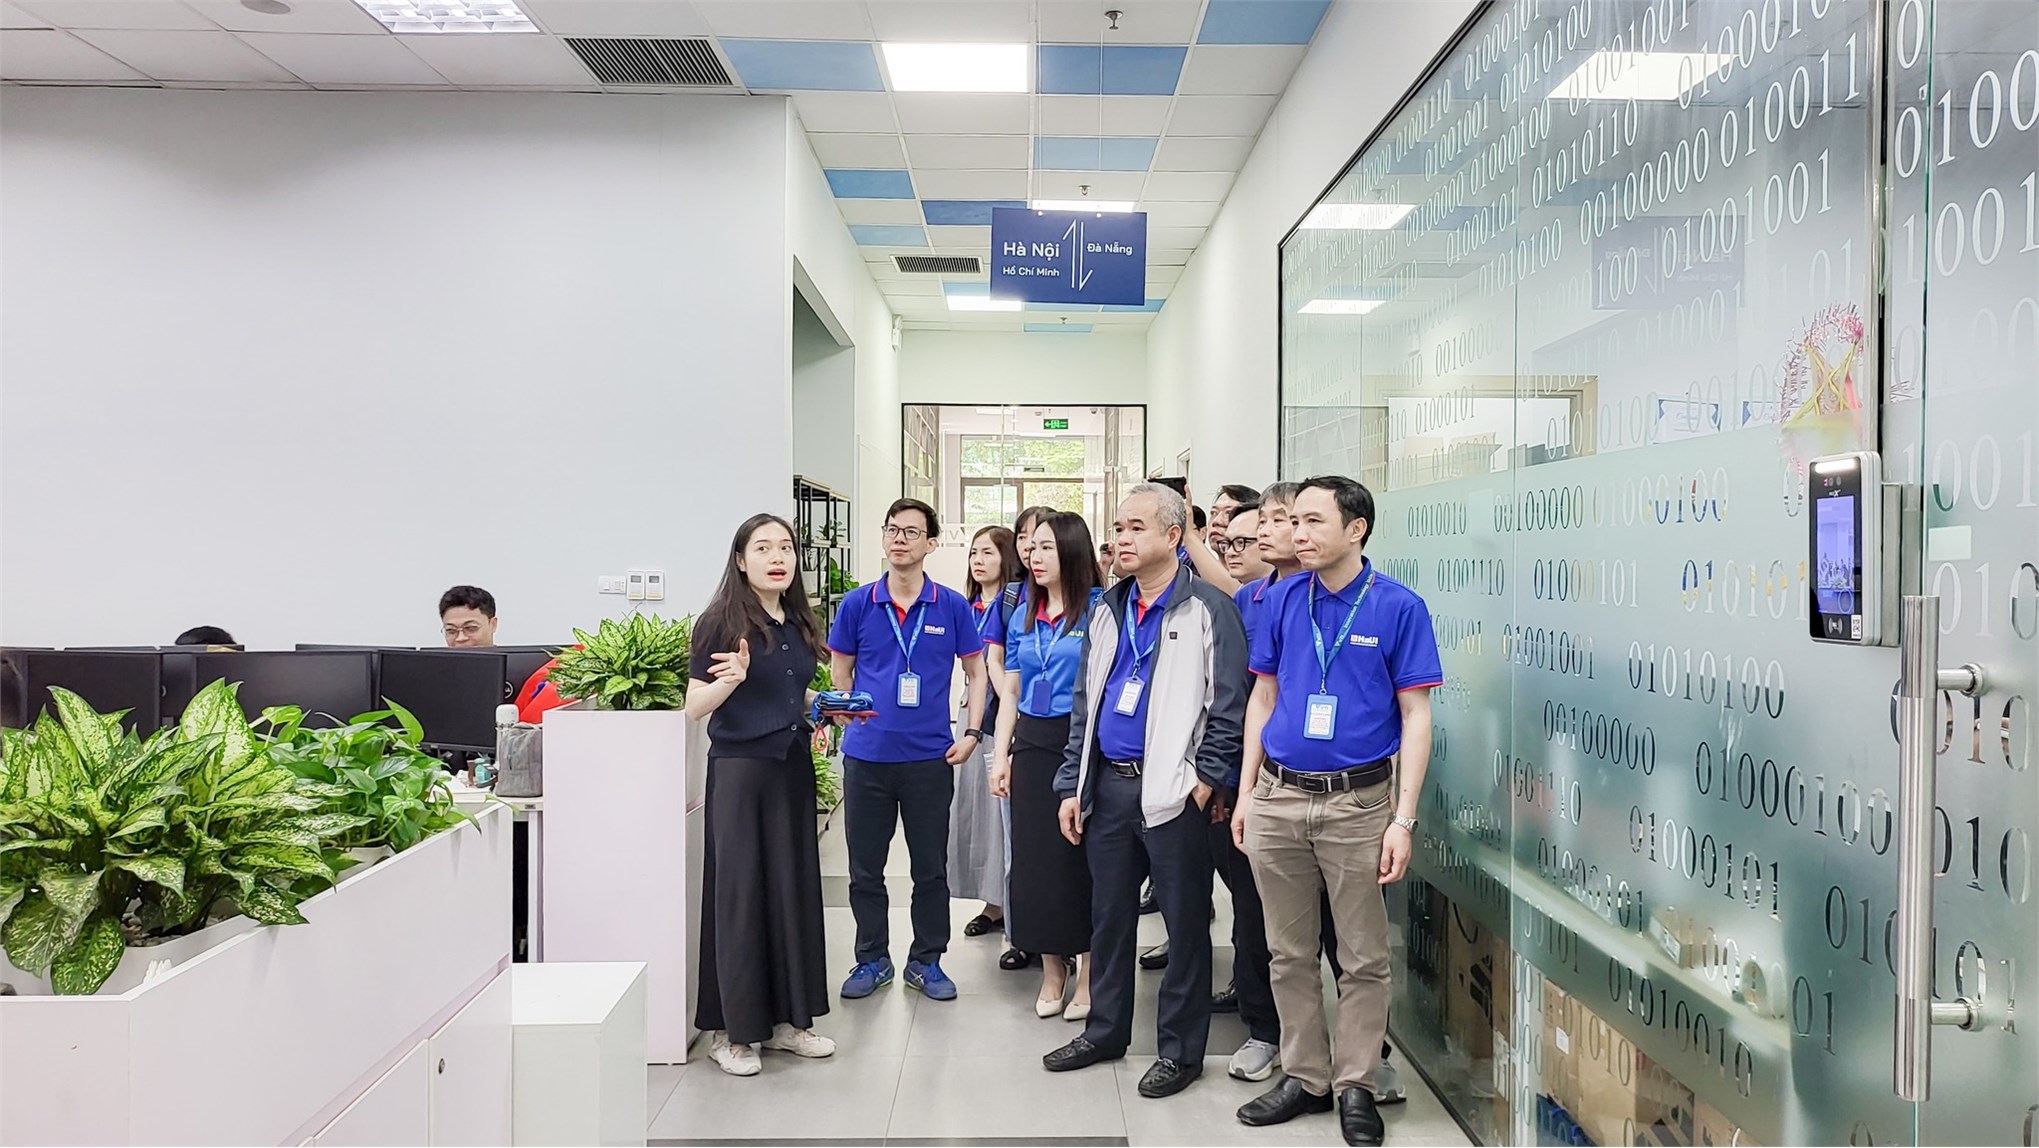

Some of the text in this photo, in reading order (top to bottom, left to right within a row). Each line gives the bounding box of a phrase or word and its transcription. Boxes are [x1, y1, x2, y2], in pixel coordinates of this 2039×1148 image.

[1395, 79, 1451, 163] 01001110
[1425, 92, 1489, 182] 01001001
[1500, 0, 1592, 113] 01010100
[1405, 171, 1464, 247] 00100000
[1470, 97, 1551, 196] 01000100
[1446, 185, 1516, 268] 01000101
[1532, 97, 1639, 209] 01010110
[1579, 127, 1711, 246] 00100000
[1662, 148, 1832, 279] 01001001
[1003, 241, 1060, 261] Hà Nội
[1018, 266, 1035, 277] Chí
[1036, 267, 1060, 278] Minh
[1086, 241, 1133, 256] Đà Nẵng
[1414, 384, 1475, 436] 01000101
[1407, 501, 1467, 538] 01010010
[1494, 485, 1584, 533] 00100000
[1437, 558, 1505, 597] 01001110
[1533, 558, 1639, 609] 01000101
[1503, 622, 1594, 679] 01001001
[1627, 640, 1786, 720] 01010100
[1542, 699, 1657, 776] 00100000
[1695, 741, 1893, 856] 01000100
[1628, 804, 1782, 923] 01000101
